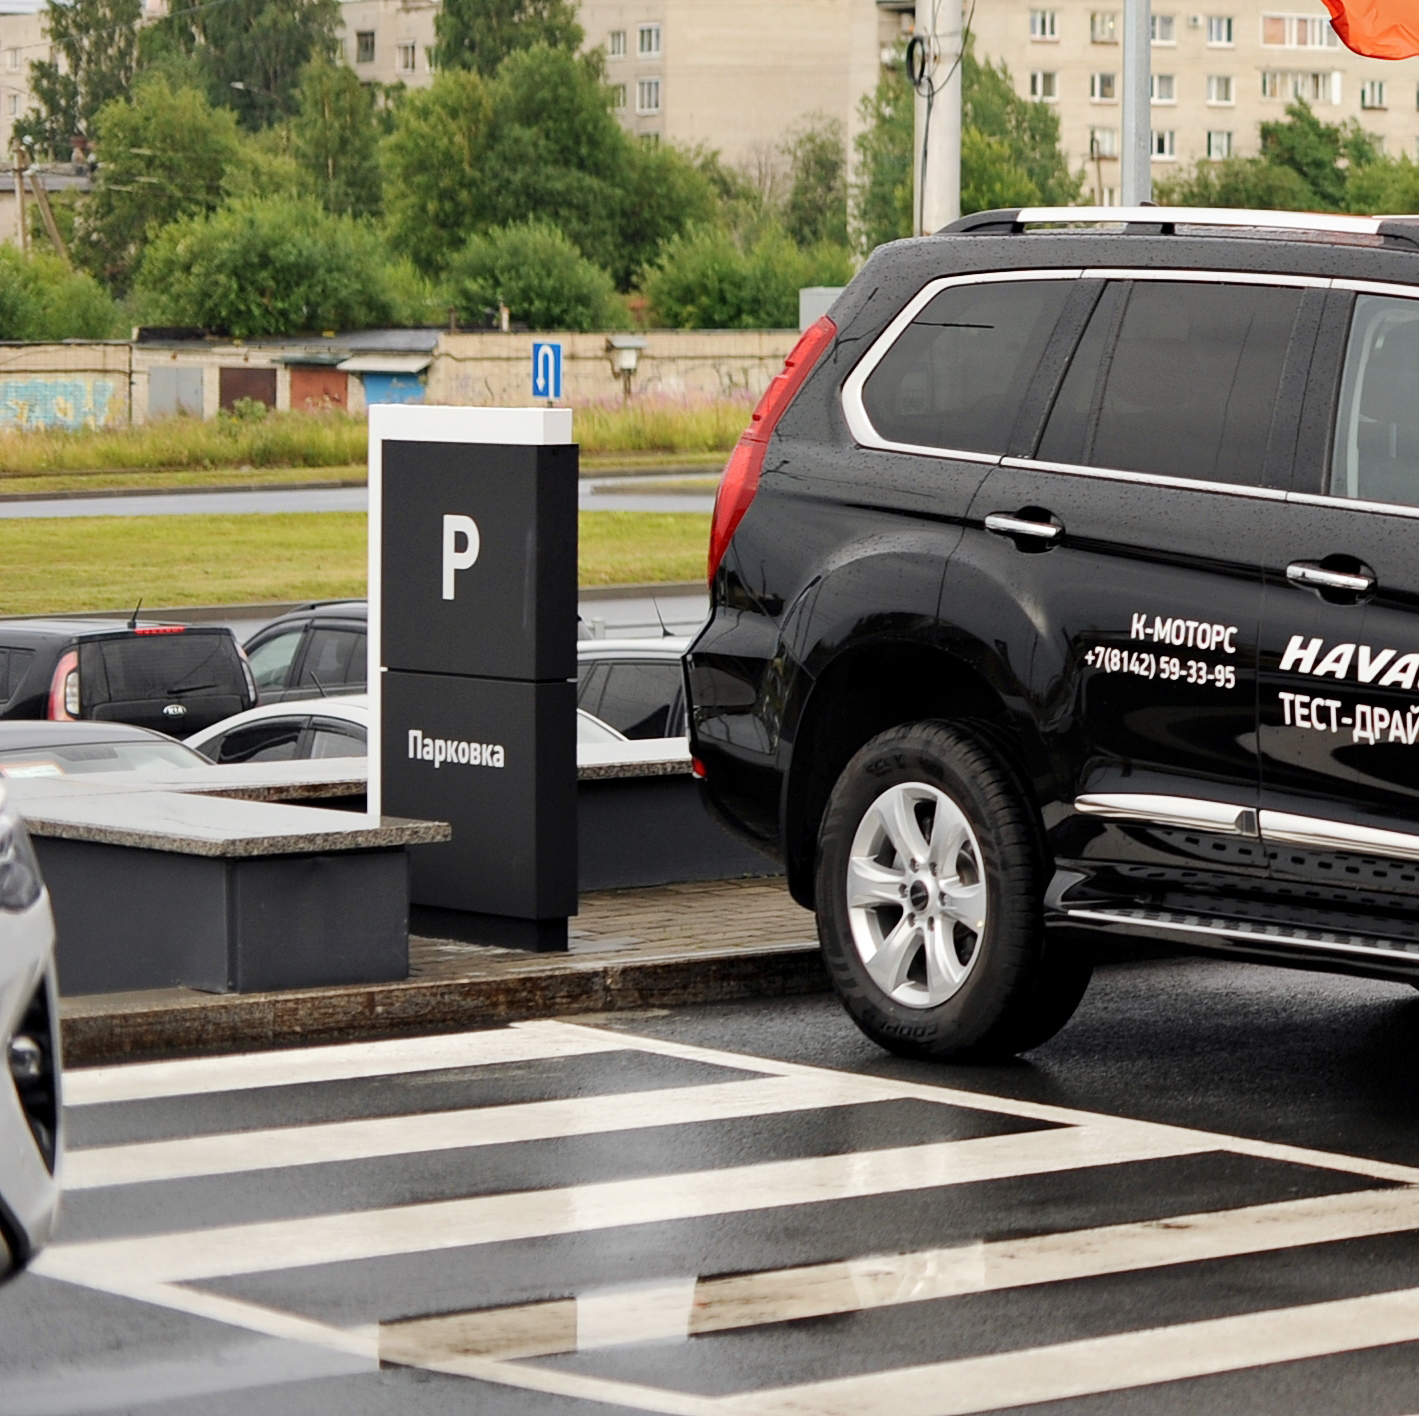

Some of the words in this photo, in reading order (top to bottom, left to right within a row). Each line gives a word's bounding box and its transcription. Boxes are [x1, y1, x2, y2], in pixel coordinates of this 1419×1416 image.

[443, 515, 480, 601] P
[1131, 612, 1238, 654] К-МОТОРС
[1085, 645, 1156, 680] +7(8142)
[1159, 655, 1236, 689] 59-33-95
[408, 729, 505, 769] Парковка
